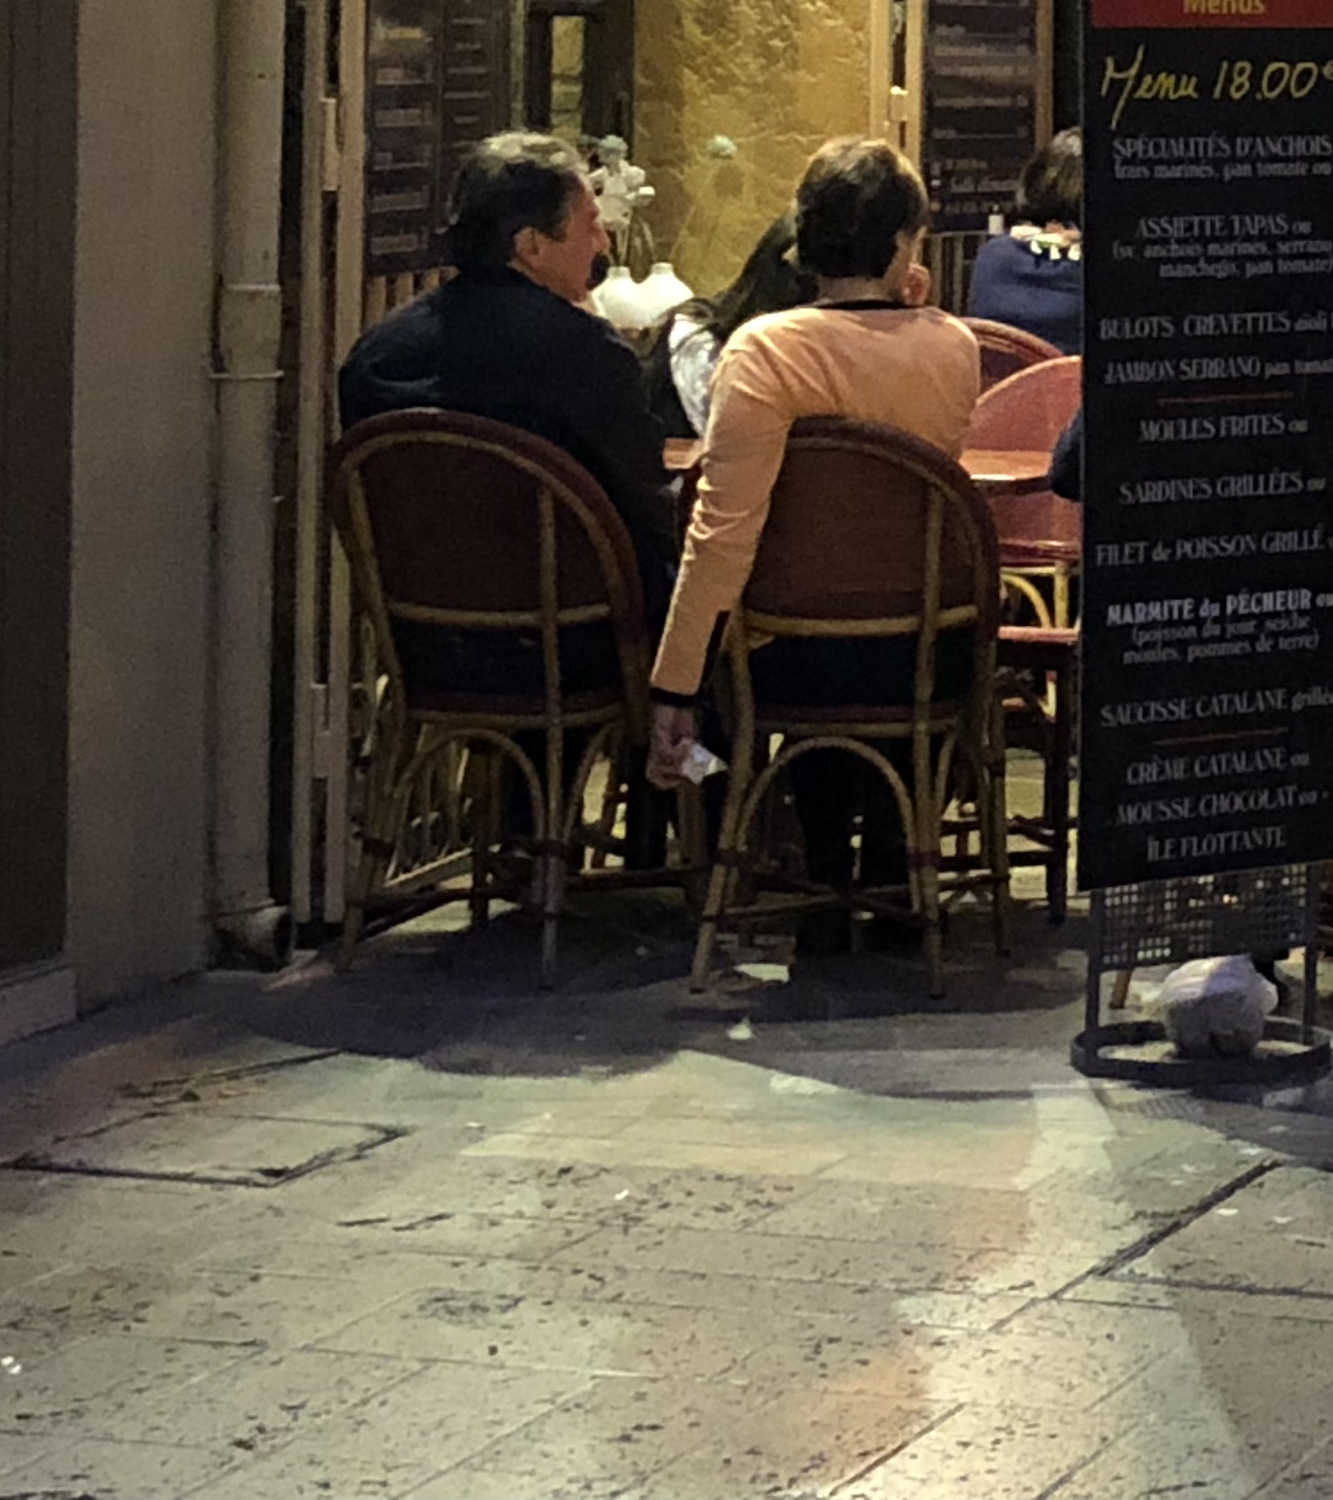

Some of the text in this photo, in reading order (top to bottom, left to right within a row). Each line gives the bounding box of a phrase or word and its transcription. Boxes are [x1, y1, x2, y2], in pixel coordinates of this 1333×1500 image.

[1100, 44, 1200, 132] Menu
[1137, 215, 1226, 238] ASSIETTE
[1230, 213, 1290, 236] TAPAS
[1100, 315, 1175, 340] BULOTS
[1183, 311, 1292, 338] CREVETTES
[1104, 359, 1176, 384] JAMBON
[1179, 356, 1261, 381] SERRANO
[1139, 417, 1216, 442] MOULES
[1218, 413, 1286, 438] FRITES
[1118, 477, 1213, 506] SARDINES
[1095, 541, 1149, 568] FILET
[1174, 534, 1258, 561] POISSON
[1106, 598, 1196, 628] MARMITE
[1100, 696, 1191, 729] SAUCISSE
[1194, 687, 1289, 719] CATALANE
[1193, 747, 1287, 778] CATALANE
[1116, 794, 1196, 826] MOUSSE
[1199, 784, 1297, 818] CHOCOLAT
[1180, 824, 1287, 858] FLOTTANTE
